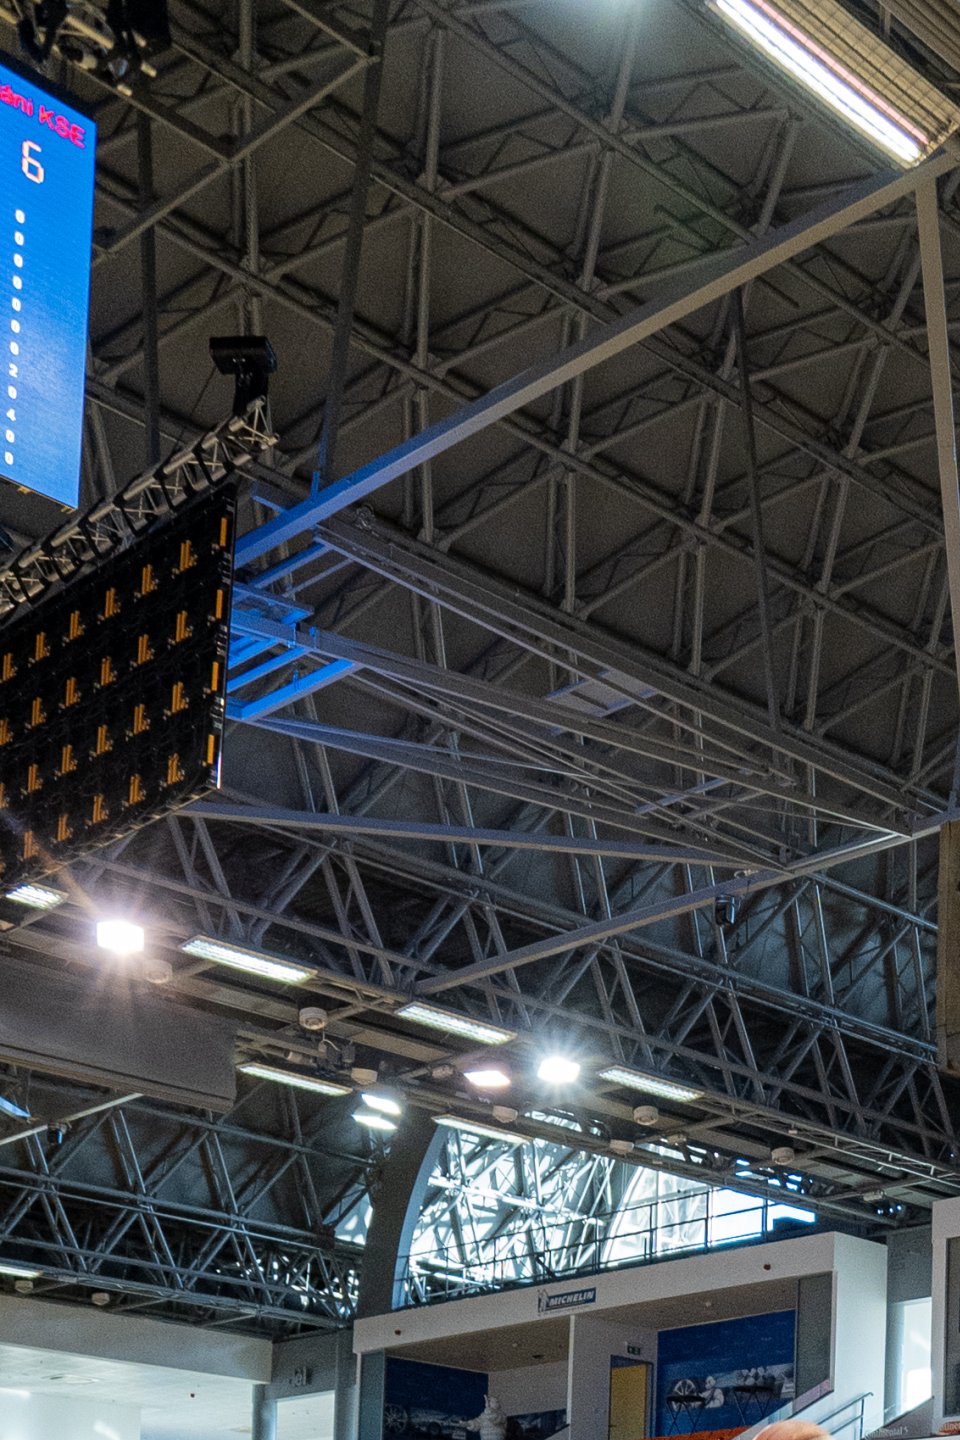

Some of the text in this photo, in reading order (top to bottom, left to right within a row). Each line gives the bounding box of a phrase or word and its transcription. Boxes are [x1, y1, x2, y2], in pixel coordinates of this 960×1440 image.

[39, 104, 85, 149] KSE
[22, 140, 44, 184] 6
[549, 1290, 595, 1307] MICHELIN
